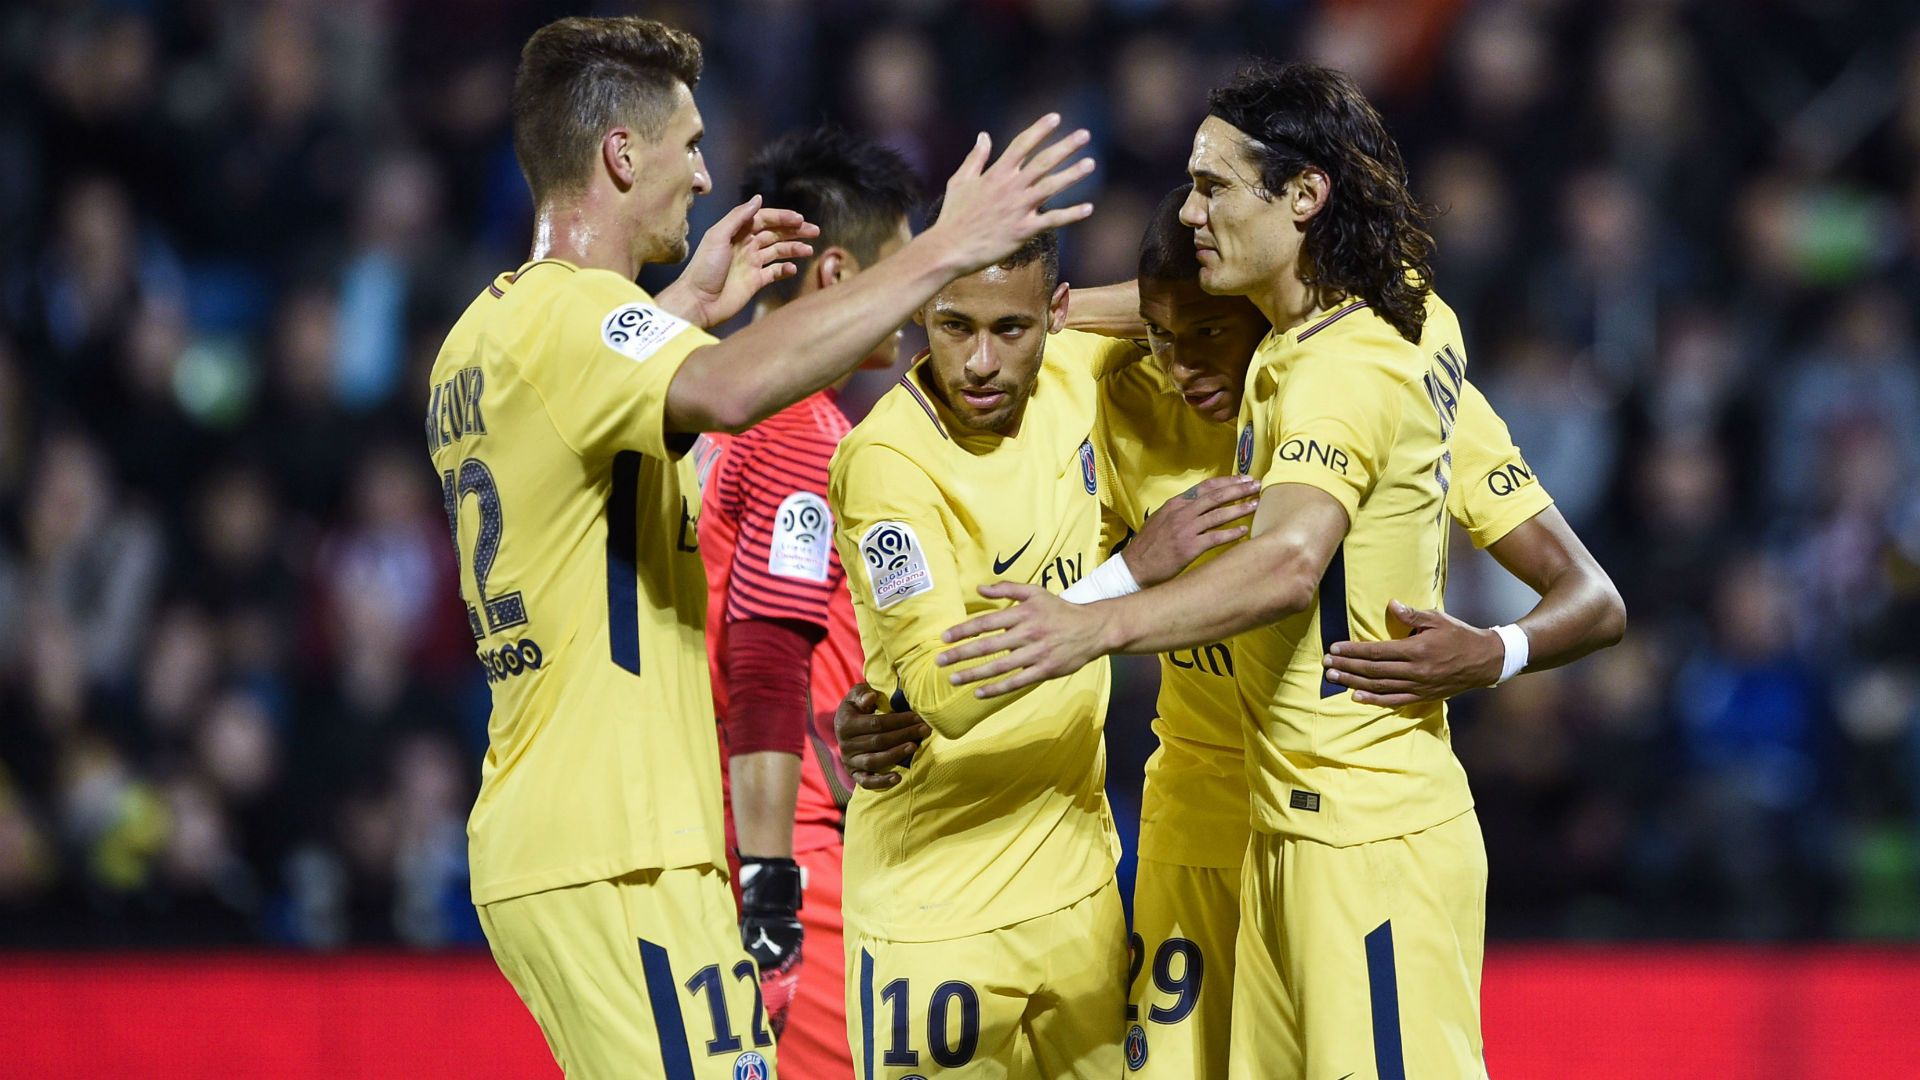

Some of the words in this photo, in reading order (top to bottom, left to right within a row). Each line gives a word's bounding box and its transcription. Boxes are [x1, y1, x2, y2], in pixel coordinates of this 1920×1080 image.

[1279, 439, 1349, 476] QNB
[1488, 458, 1531, 496] QN
[877, 570, 925, 595] Conforama
[879, 566, 910, 585] LIGUE
[1126, 932, 1204, 1025] 29
[684, 959, 773, 1057] 12
[880, 978, 980, 1068] 10
